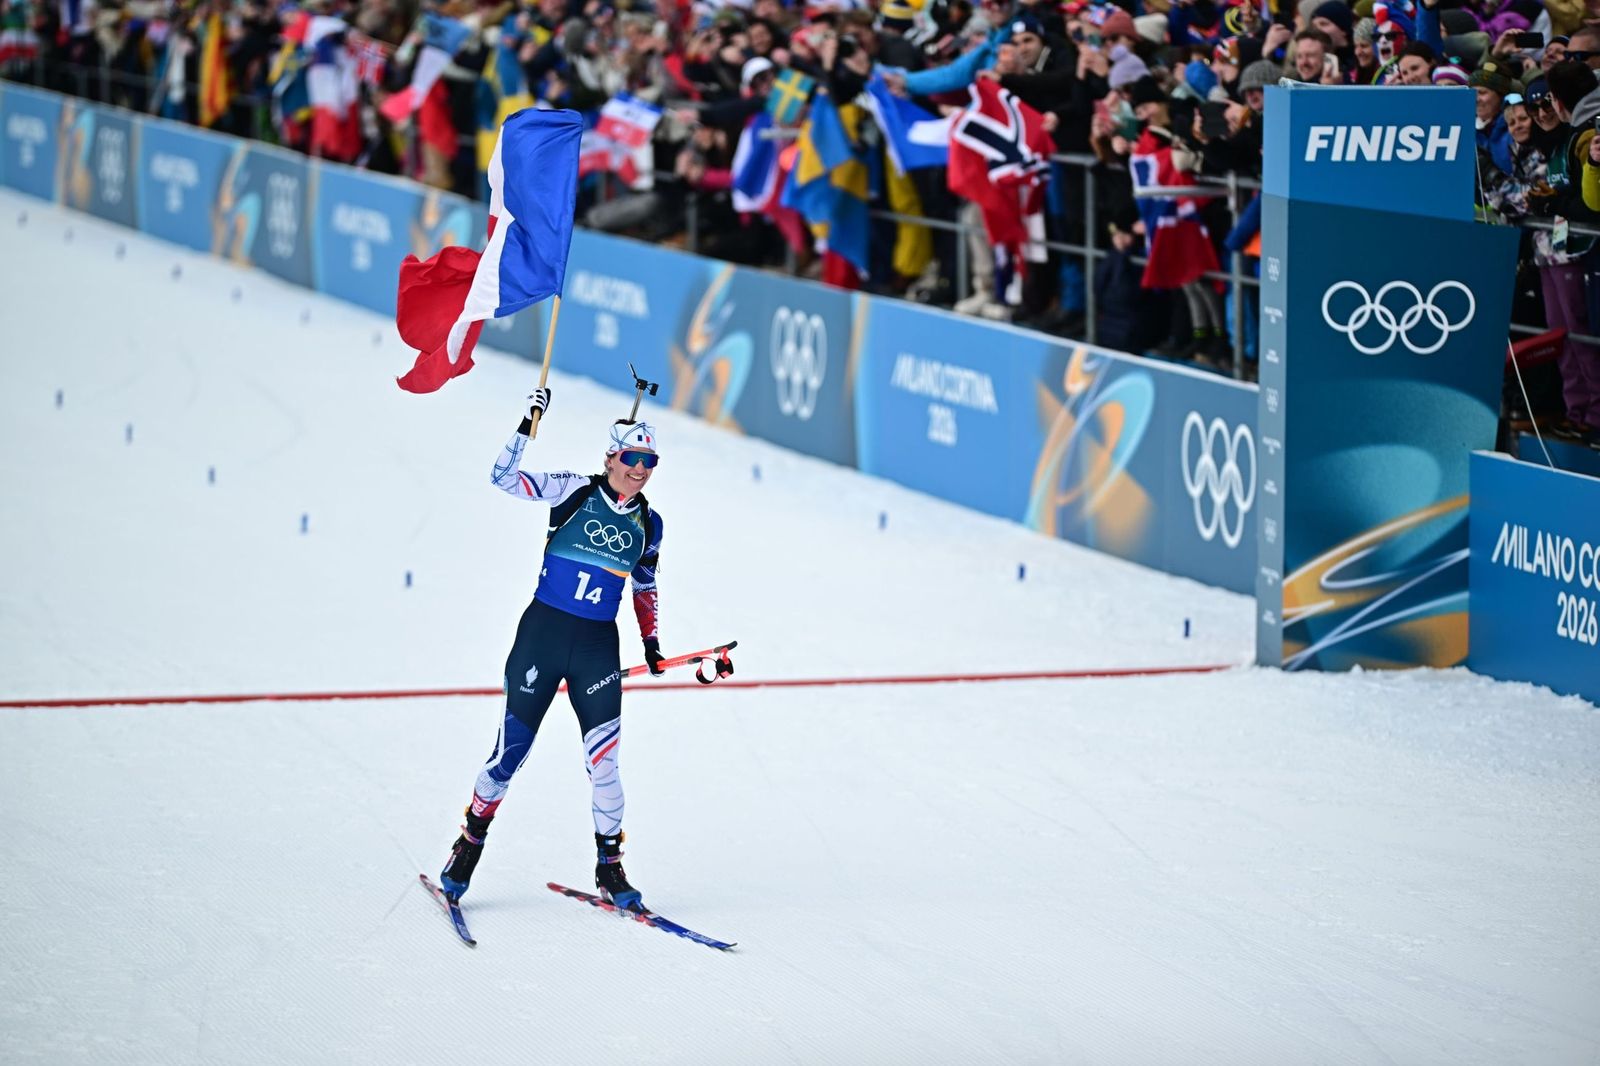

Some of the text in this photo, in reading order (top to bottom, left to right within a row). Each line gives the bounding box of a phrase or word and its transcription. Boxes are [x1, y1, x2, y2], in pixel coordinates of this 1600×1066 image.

[1305, 125, 1461, 162] FINISH
[572, 543, 598, 554] MILANO
[597, 550, 620, 562] CORTINA
[1491, 521, 1576, 584] MILANO
[1557, 591, 1598, 646] 2026
[586, 673, 616, 695] CRAFT
